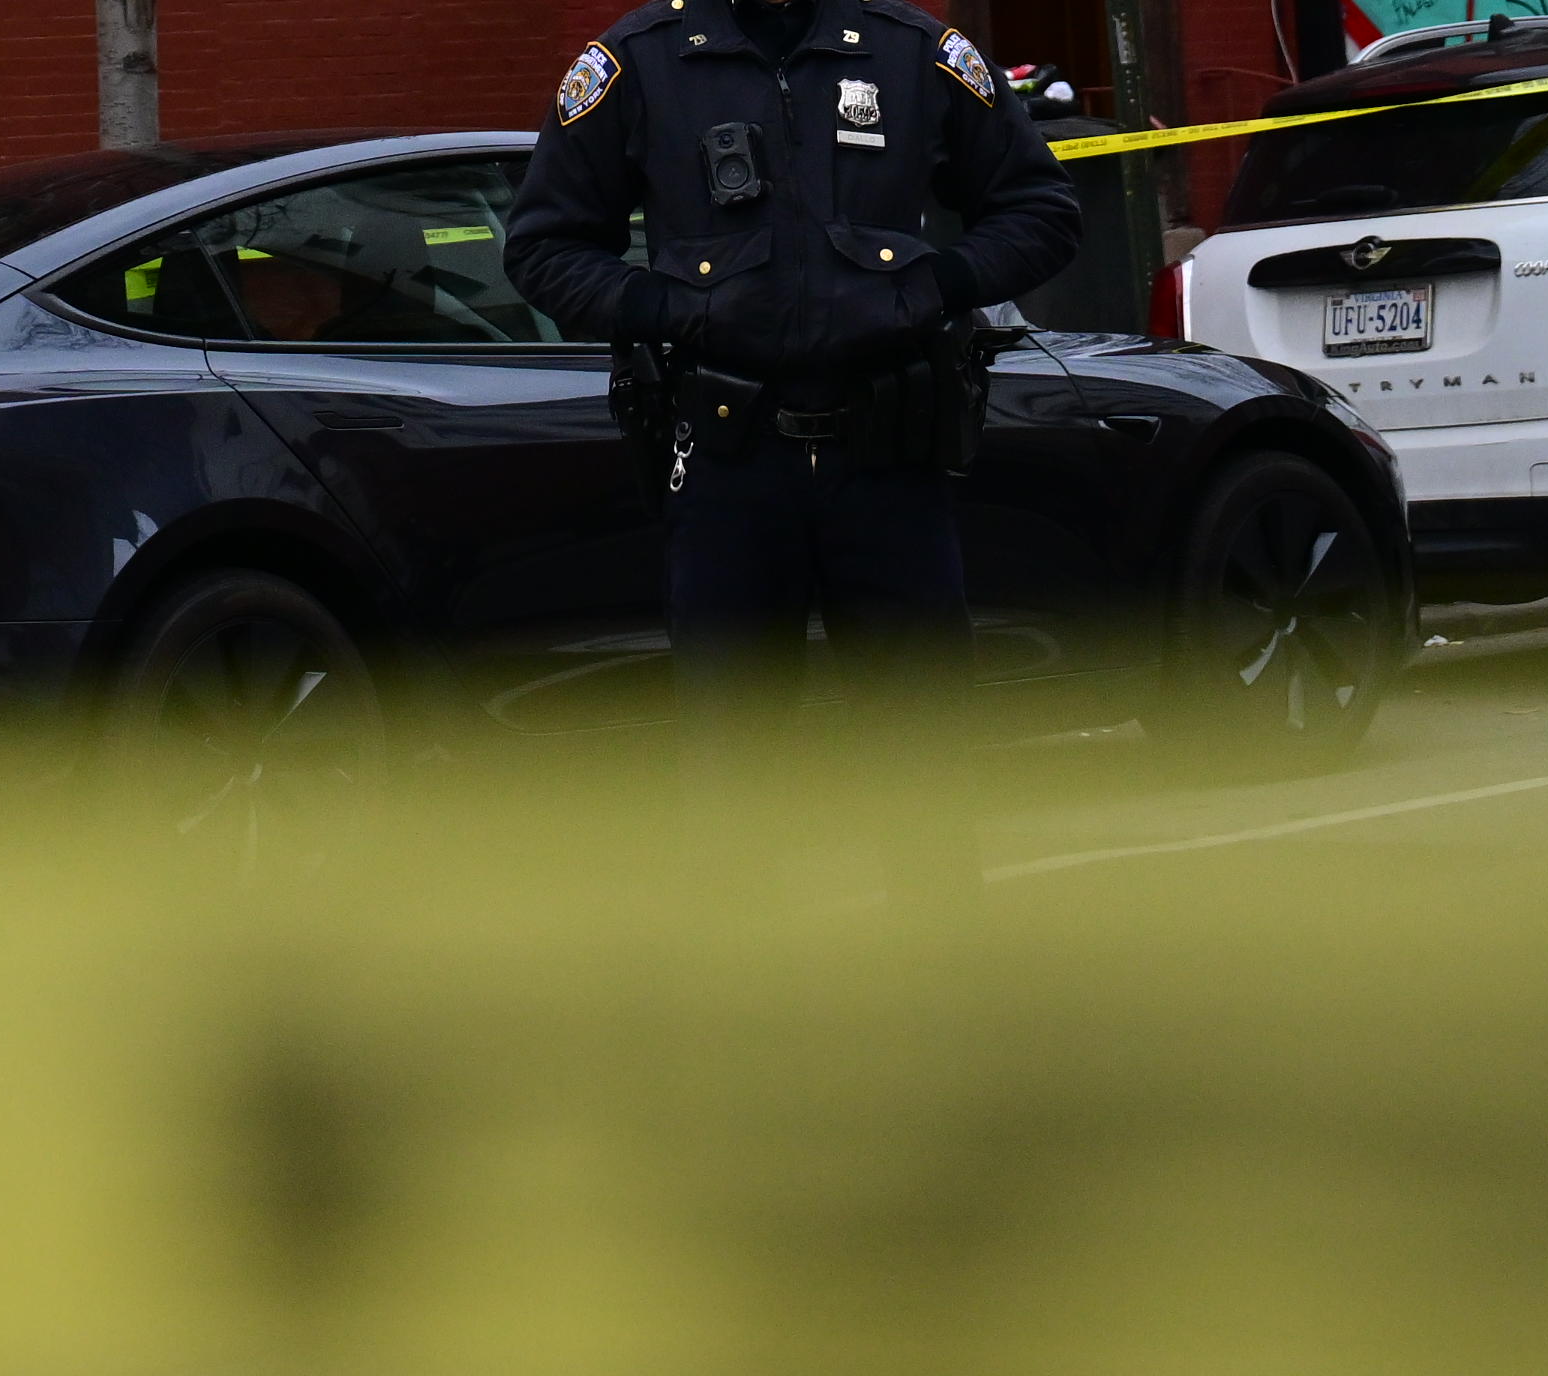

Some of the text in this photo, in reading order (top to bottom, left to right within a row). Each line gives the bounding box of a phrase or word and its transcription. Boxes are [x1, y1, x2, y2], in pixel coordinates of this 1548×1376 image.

[584, 86, 604, 107] YORK
[1353, 290, 1404, 303] VIRGINIA
[1332, 301, 1422, 336] UFU-5204
[1348, 371, 1536, 393] TRYMAN
